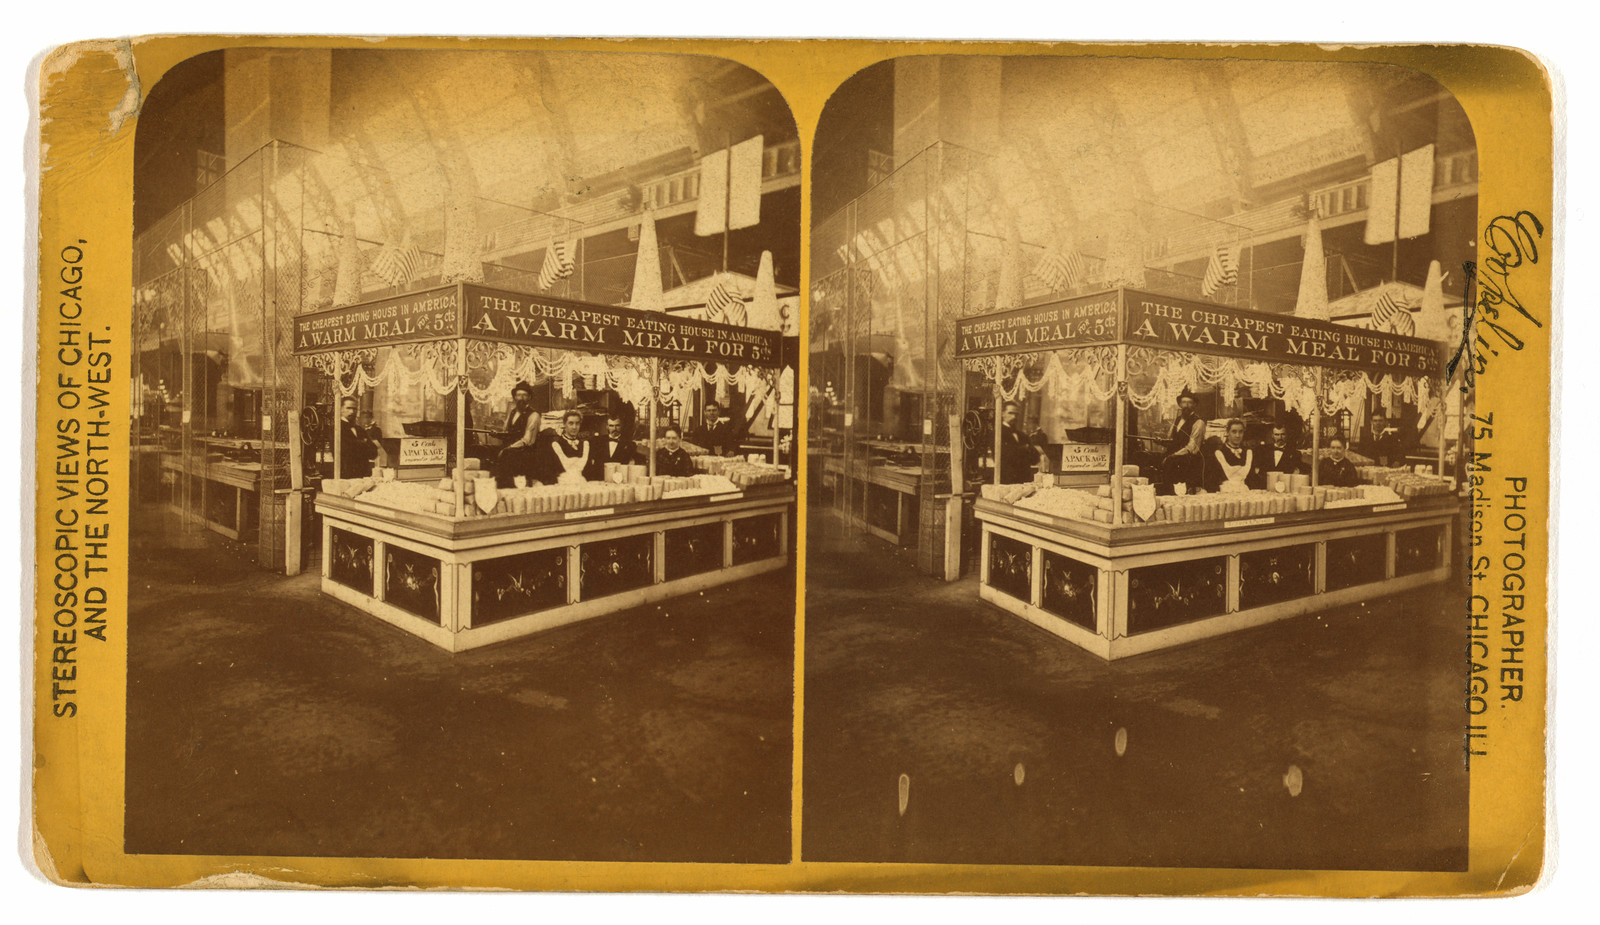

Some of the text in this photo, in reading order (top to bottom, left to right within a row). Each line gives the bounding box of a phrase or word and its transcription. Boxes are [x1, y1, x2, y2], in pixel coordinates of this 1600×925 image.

[298, 334, 308, 348] A
[311, 326, 357, 346] WARM
[363, 317, 416, 340] MEAL
[417, 313, 430, 330] FOR
[299, 295, 457, 332] THE CHEAPEST EATING HOUSE IN AMERICA
[472, 312, 498, 334] A
[506, 315, 606, 344] WARM
[622, 330, 695, 352] MEAL
[705, 339, 745, 358] FOR
[480, 295, 521, 313] THE
[529, 303, 620, 327] CHEAPEST
[626, 317, 676, 334] EATING
[679, 325, 715, 340] HOUSE
[717, 330, 728, 341] IN
[961, 301, 1117, 336] THE CHEAPEST EATING HOUSE IN AMERICA
[961, 337, 970, 351] A
[973, 330, 1018, 349] WARM
[1025, 322, 1076, 344] MEAL
[1141, 301, 1183, 320] THE
[1191, 310, 1284, 334] CHEAPEST
[1291, 325, 1341, 343] EATING
[1345, 334, 1380, 348] HOUSE
[1383, 339, 1394, 350] IN
[1133, 318, 1159, 338] A
[1168, 321, 1269, 351] WARM
[1286, 338, 1360, 362] MEAL
[1371, 350, 1410, 367] FOR
[1470, 411, 1493, 440] 75
[53, 239, 88, 718] STEREOSCOPIC VIEWS OF CHICAGO,
[84, 326, 112, 642] AND THE NORTH-WEST.
[1468, 452, 1492, 546] Madison
[1501, 478, 1528, 709] PHOTOGRAPHER.
[1464, 594, 1489, 716] CHICAGO
